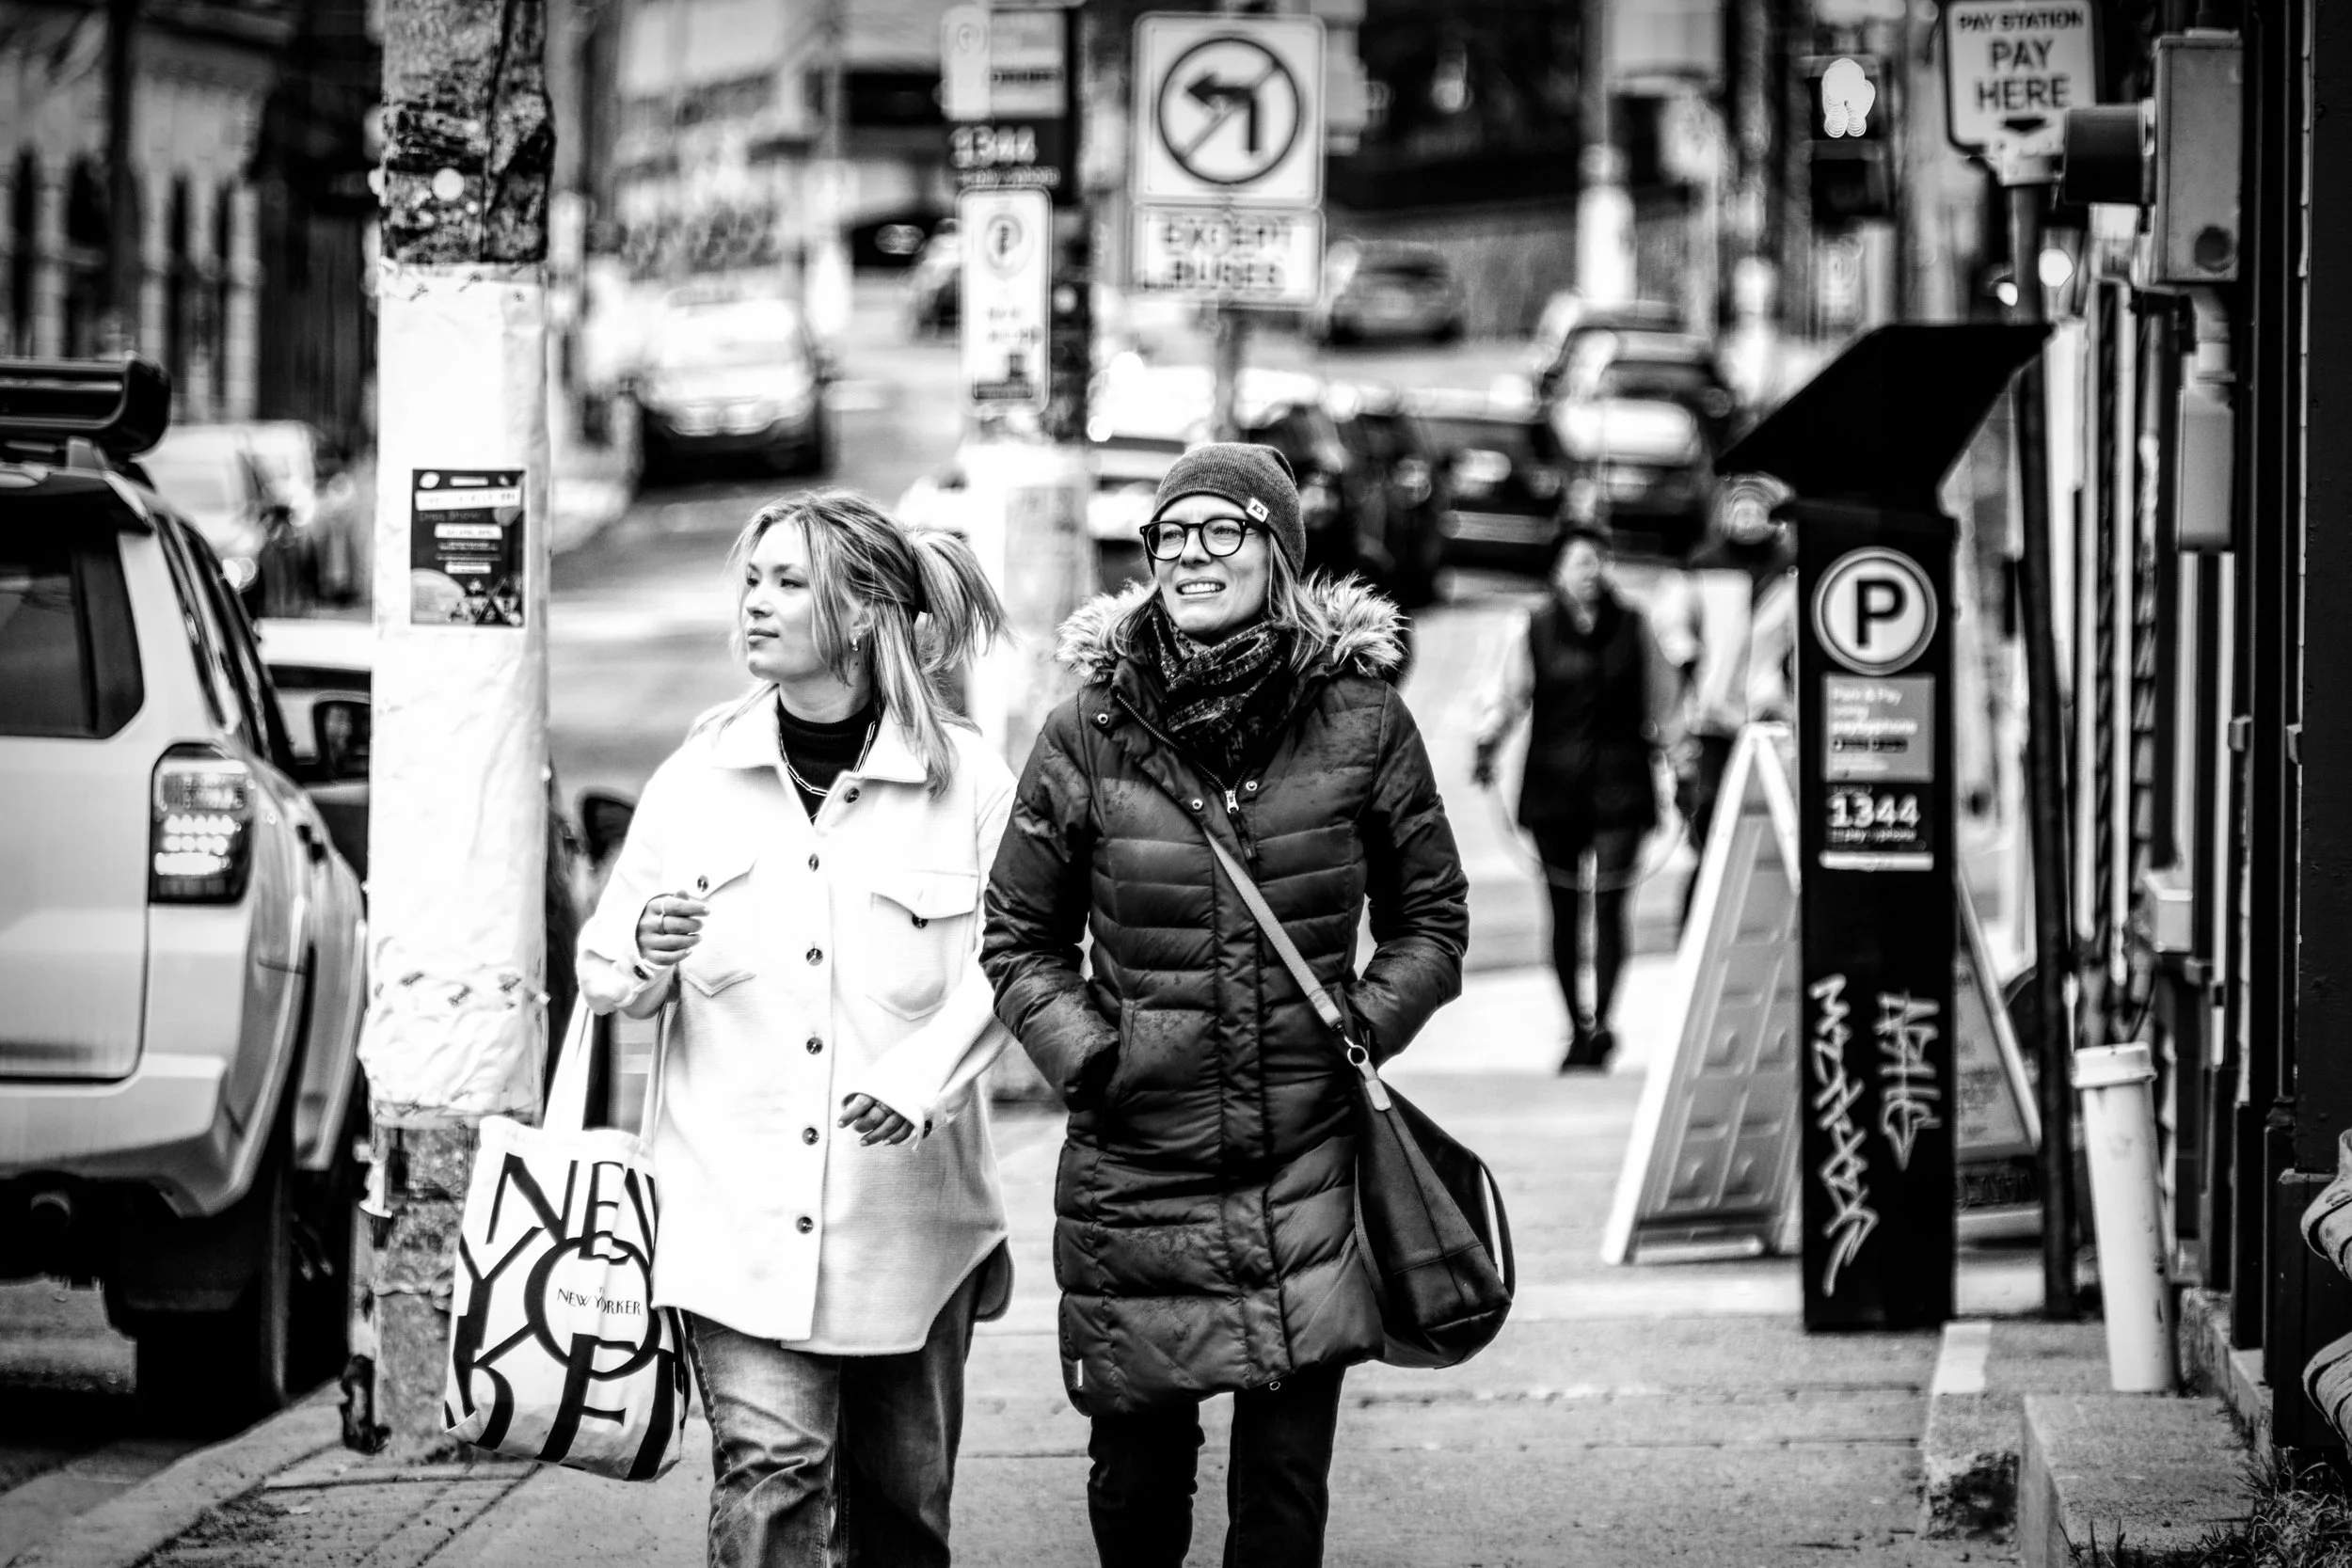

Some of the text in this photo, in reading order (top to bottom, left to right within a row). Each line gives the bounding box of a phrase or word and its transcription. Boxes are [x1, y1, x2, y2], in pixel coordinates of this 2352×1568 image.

[1959, 8, 2084, 31] PAY STATION
[1987, 38, 2055, 71] PAY
[1977, 76, 2070, 111] HERE
[1855, 578, 1908, 649] P
[1827, 793, 1920, 828] 1344
[557, 1288, 591, 1307] NEW
